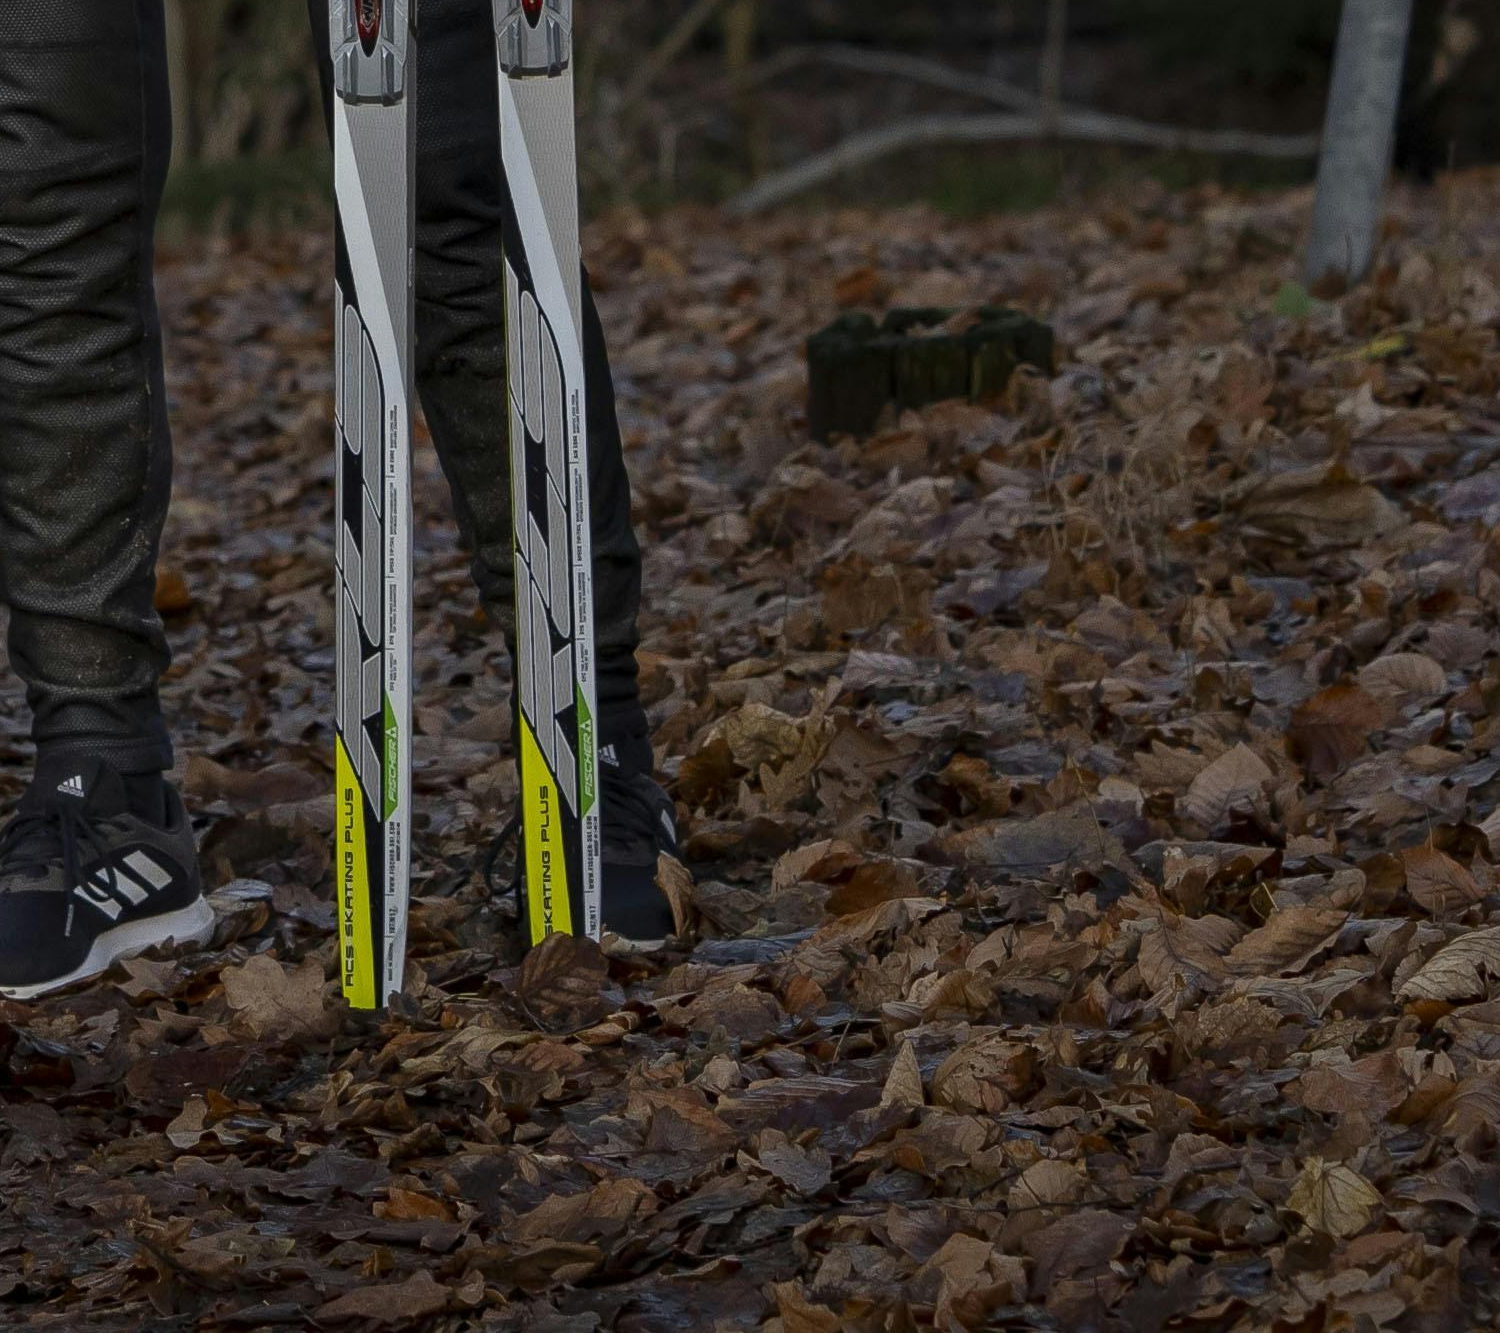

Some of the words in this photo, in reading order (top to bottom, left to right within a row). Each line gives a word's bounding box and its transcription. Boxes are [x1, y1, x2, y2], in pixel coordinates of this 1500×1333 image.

[388, 739, 397, 803] FISCHER
[583, 732, 593, 798] FISCHER
[345, 787, 354, 844] PLUS
[540, 785, 550, 843] PLUS
[345, 851, 355, 937] SKATING
[541, 850, 554, 936] SKATING
